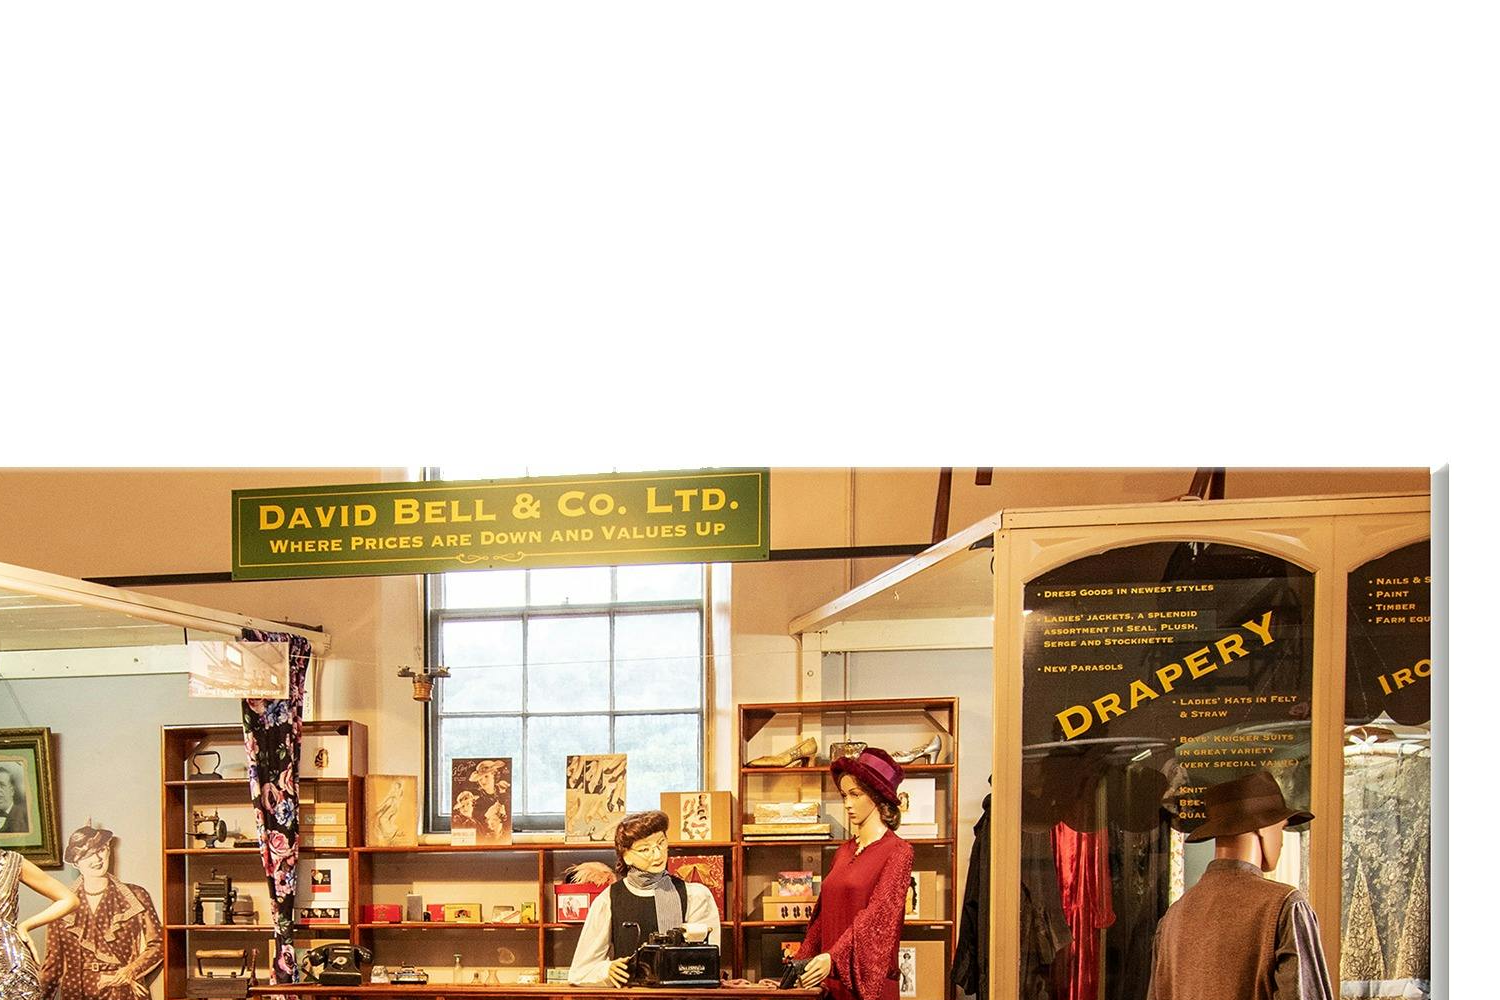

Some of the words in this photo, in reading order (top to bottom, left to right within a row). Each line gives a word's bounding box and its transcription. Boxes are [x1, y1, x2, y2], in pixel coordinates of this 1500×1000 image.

[259, 503, 377, 531] DAVID
[393, 497, 496, 525] BELL
[512, 493, 540, 519] &
[557, 490, 626, 517] CO.
[646, 487, 738, 513] LTD.
[1054, 610, 1278, 741] DRAPERY
